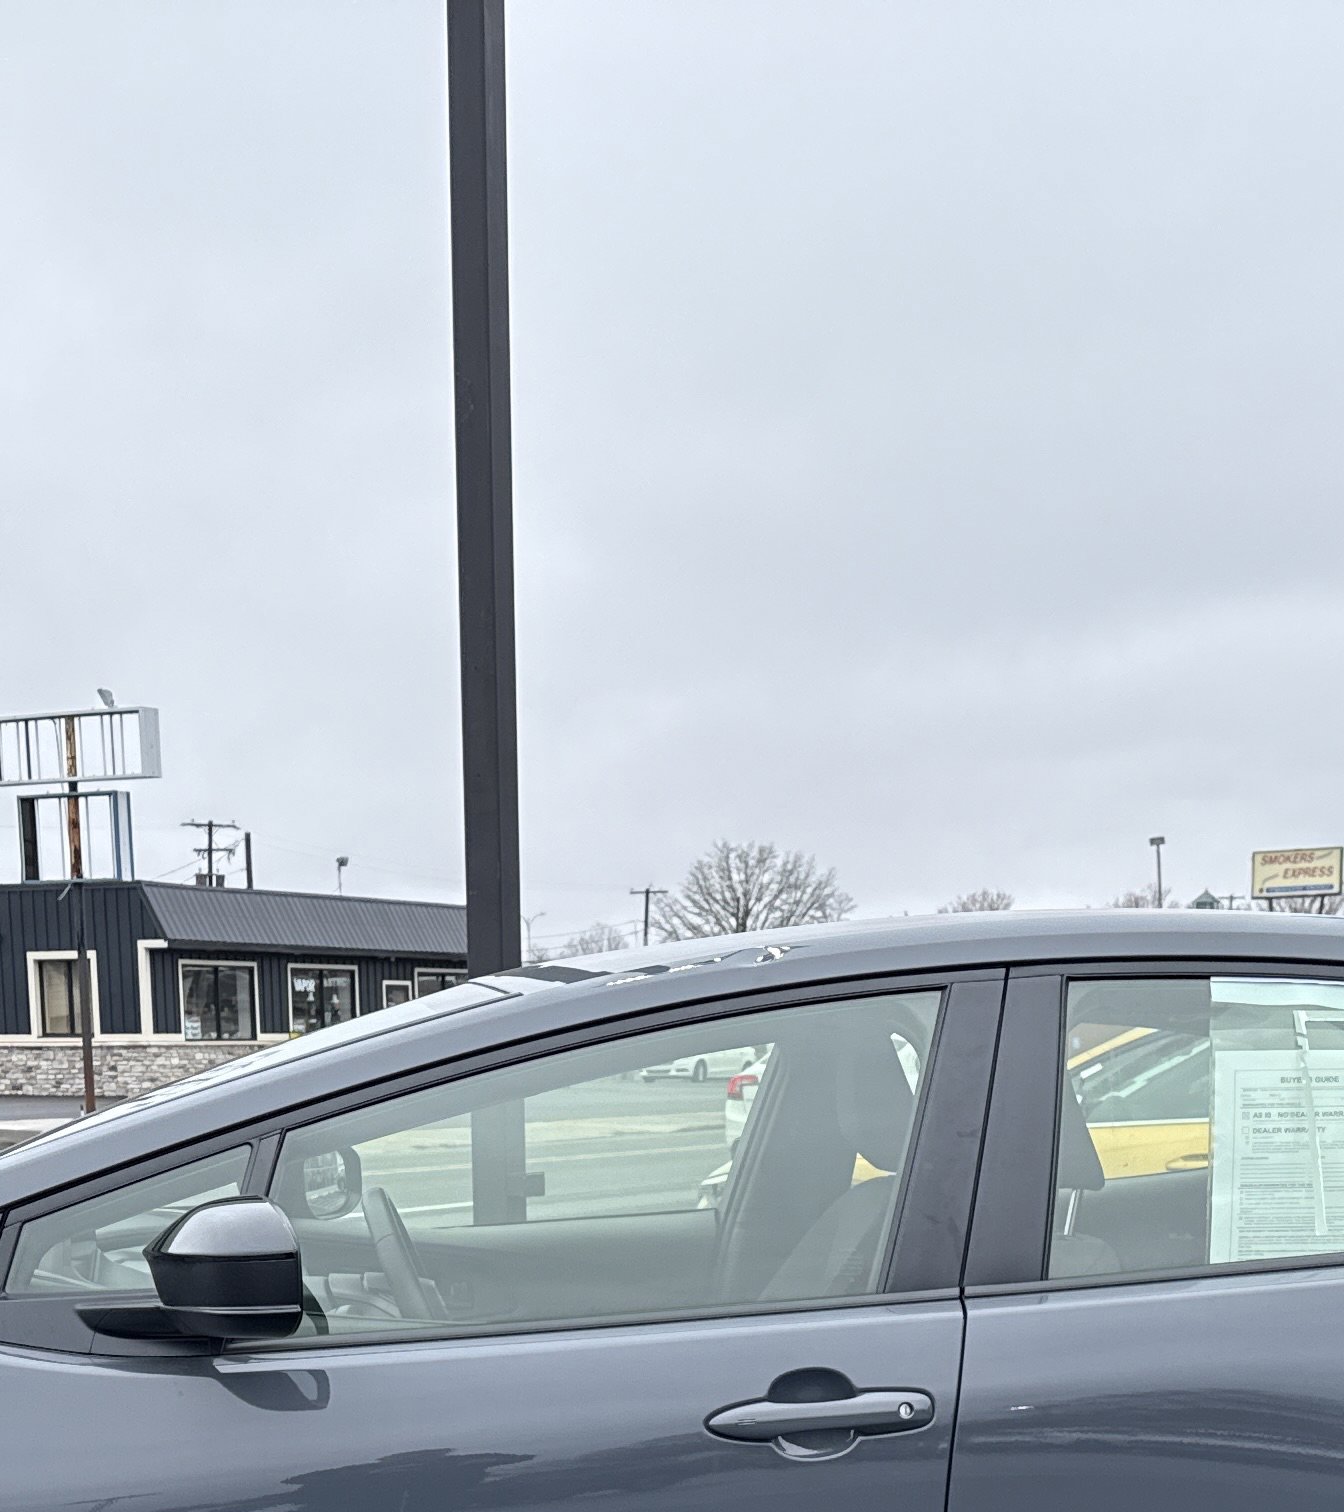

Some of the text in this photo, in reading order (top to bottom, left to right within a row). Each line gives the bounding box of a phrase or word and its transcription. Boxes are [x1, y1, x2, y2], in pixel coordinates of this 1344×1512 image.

[1261, 852, 1315, 866] SMOKERS
[1283, 866, 1334, 879] EXPRESS
[1280, 1076, 1313, 1084] BUYES
